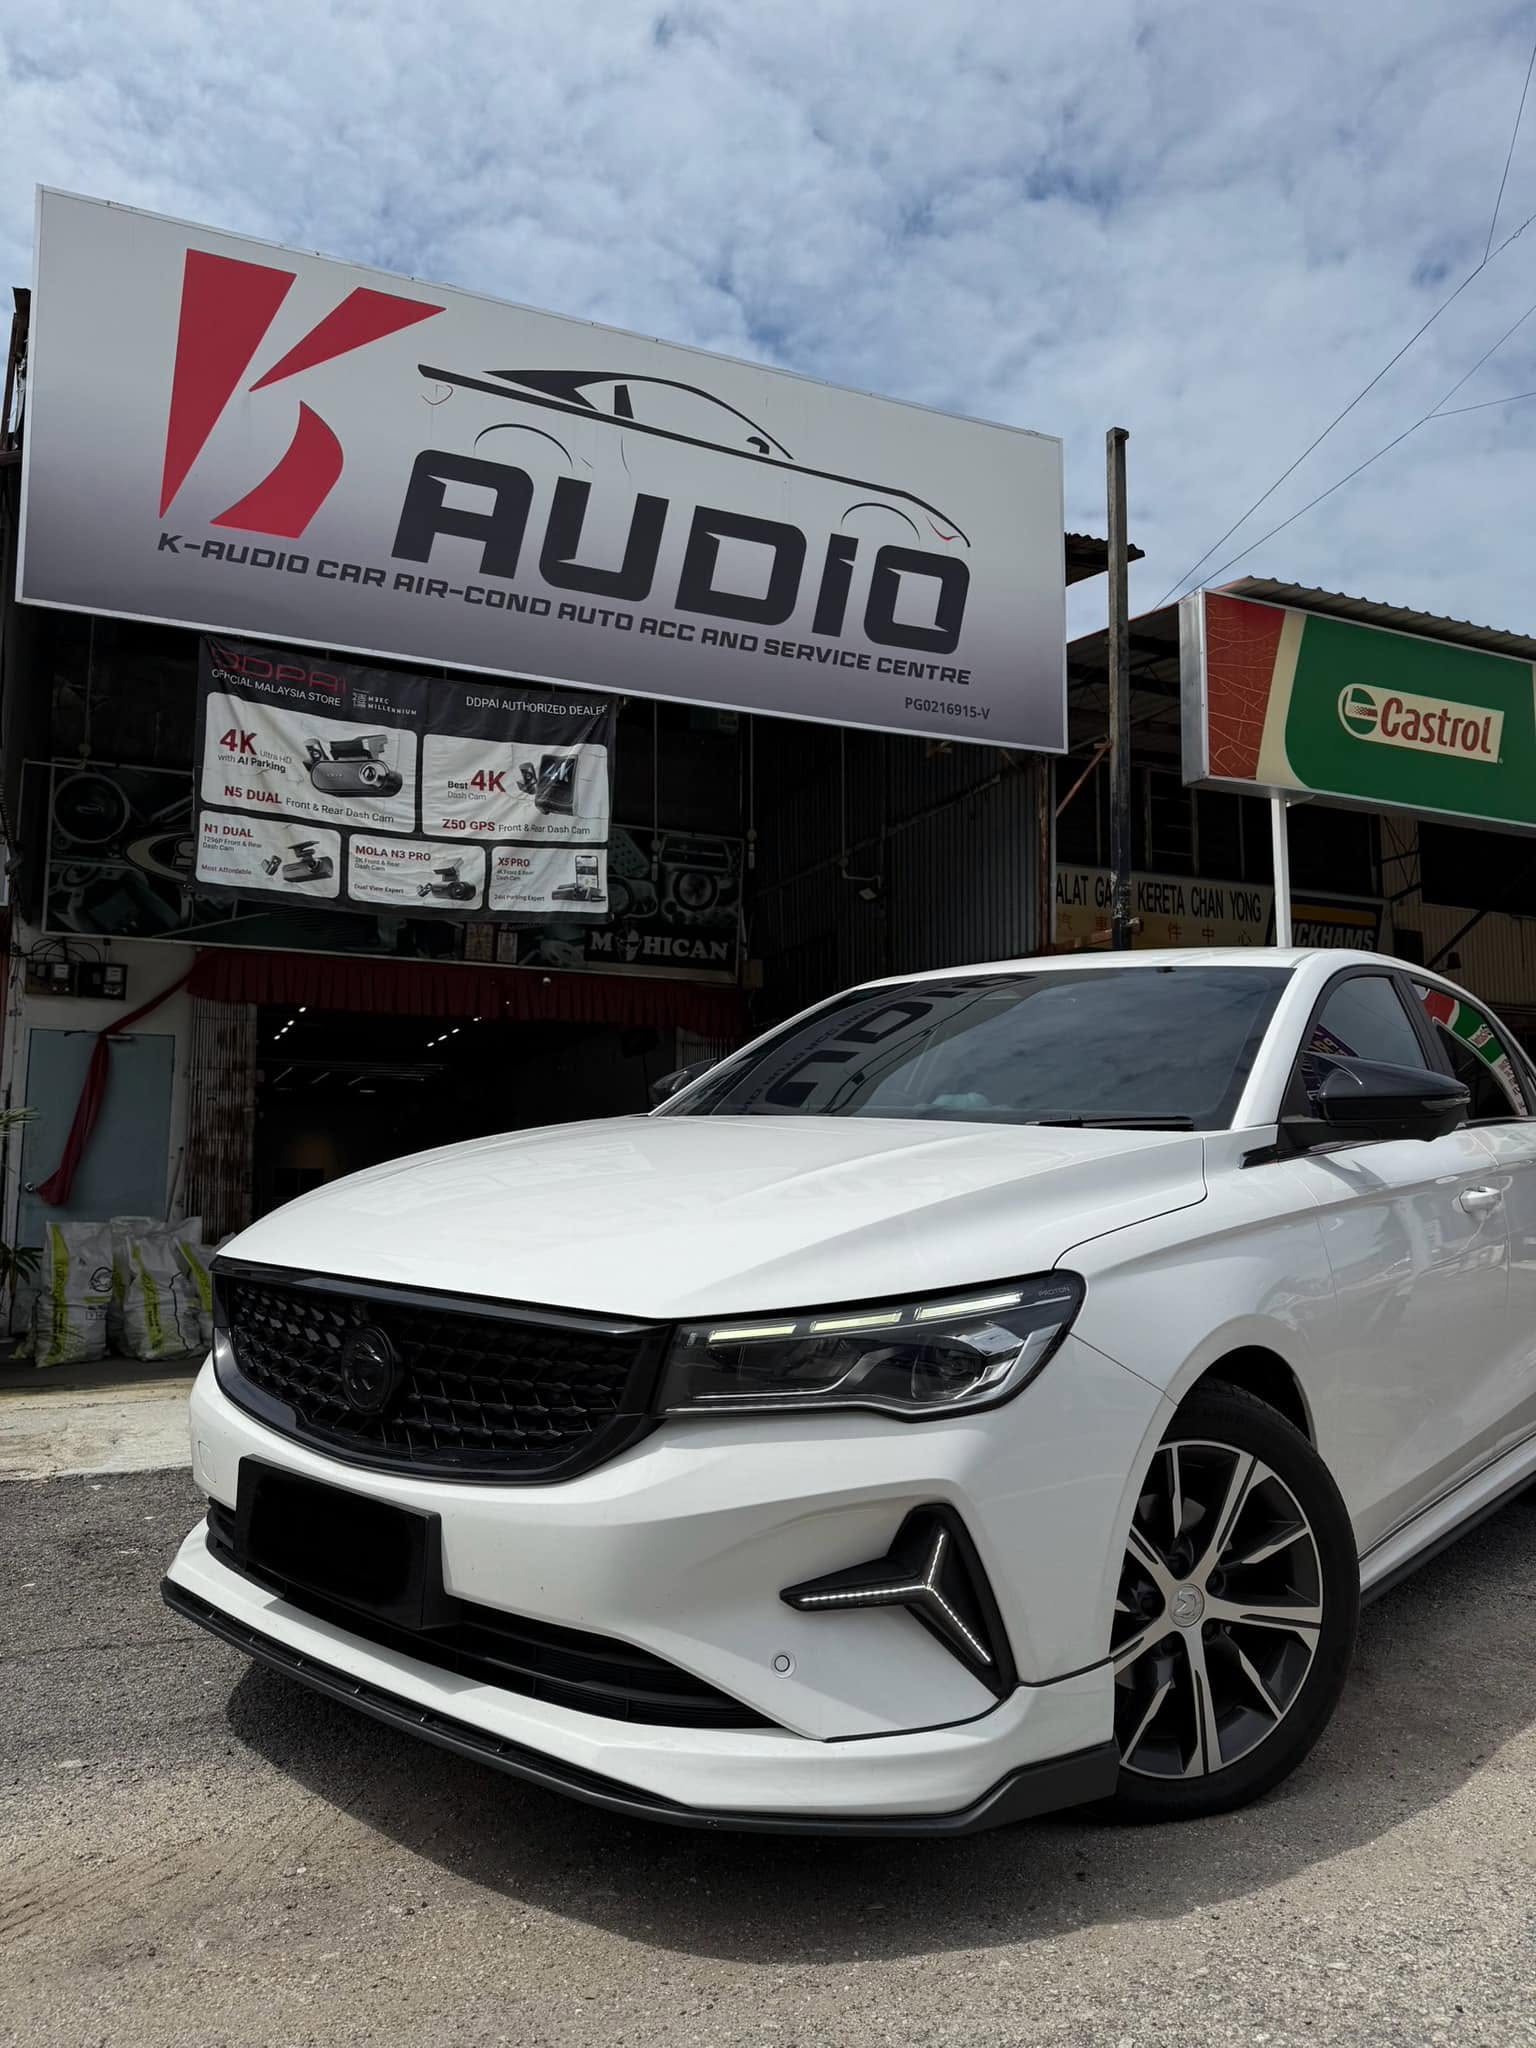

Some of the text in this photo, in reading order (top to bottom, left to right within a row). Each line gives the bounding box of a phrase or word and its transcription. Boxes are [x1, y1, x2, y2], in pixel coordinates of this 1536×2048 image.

[391, 449, 970, 655] AUDIO
[157, 532, 972, 685] K-AUDIO CAR AIR-COND AUTO ACC AND SERVICE CENTRE
[255, 680, 307, 700] MALAYSIA
[307, 691, 342, 707] STORE
[466, 695, 500, 709] DDPAI
[502, 699, 567, 715] AUTHORIZED
[904, 697, 991, 720] PG0216915-V
[1380, 697, 1492, 754] Castrol
[219, 729, 257, 755] 4K
[217, 753, 287, 774] with AI Parking
[447, 769, 506, 793] Best 4K
[224, 785, 395, 824] N5 DUAL Front & Rear Dash Cam
[447, 791, 487, 801] Dash Cam
[204, 823, 254, 838] N1 DUAL
[442, 818, 466, 830] Z50
[470, 820, 496, 832] GPS
[498, 824, 522, 833] Front
[547, 825, 570, 834] Dash
[571, 826, 591, 835] Cam
[355, 845, 431, 861] MOLA N3 PRO
[384, 887, 404, 895] Expert
[1056, 873, 1089, 905] ALAT
[1137, 880, 1186, 916] KERETA
[1191, 886, 1224, 919] CHAN
[1230, 890, 1263, 922] YONG
